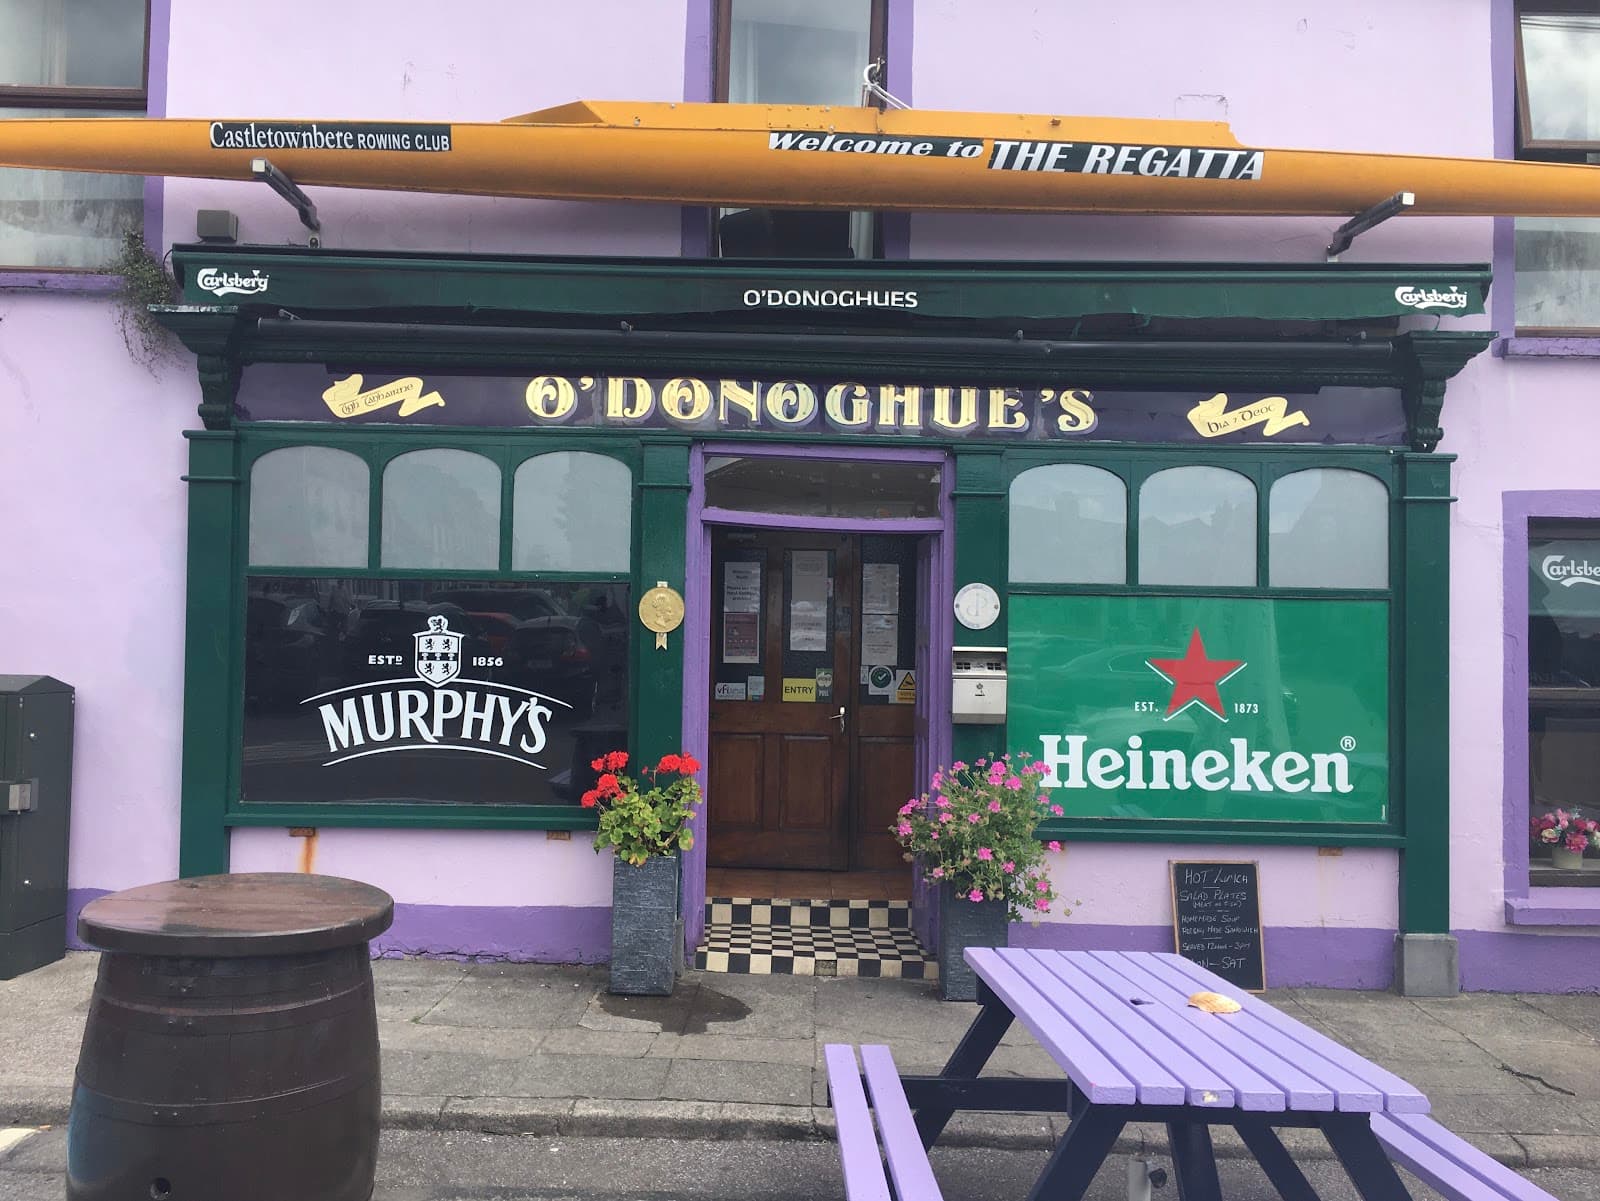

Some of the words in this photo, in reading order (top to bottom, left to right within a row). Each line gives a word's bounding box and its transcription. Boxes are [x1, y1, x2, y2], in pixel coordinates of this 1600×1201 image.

[209, 122, 353, 148] Castletownbere
[357, 133, 411, 150] ROWING
[414, 134, 450, 151] CLUB
[768, 132, 934, 156] Welcome
[946, 140, 984, 158] to
[991, 141, 1072, 173] THE
[1082, 144, 1265, 180] REGATTA
[197, 268, 269, 296] Carlsberg
[743, 289, 918, 308] O'DONOGHUES
[1394, 286, 1467, 309] Carlsberg
[525, 375, 1096, 432] O'DONOGHUE'S
[472, 656, 504, 667] 1856
[784, 686, 814, 694] ENTRY
[1134, 702, 1159, 712] EST.
[1234, 703, 1259, 714] 1873
[318, 689, 552, 754] MURPHY'S
[1039, 735, 1354, 793] Heineken
[1185, 868, 1210, 884] HOT
